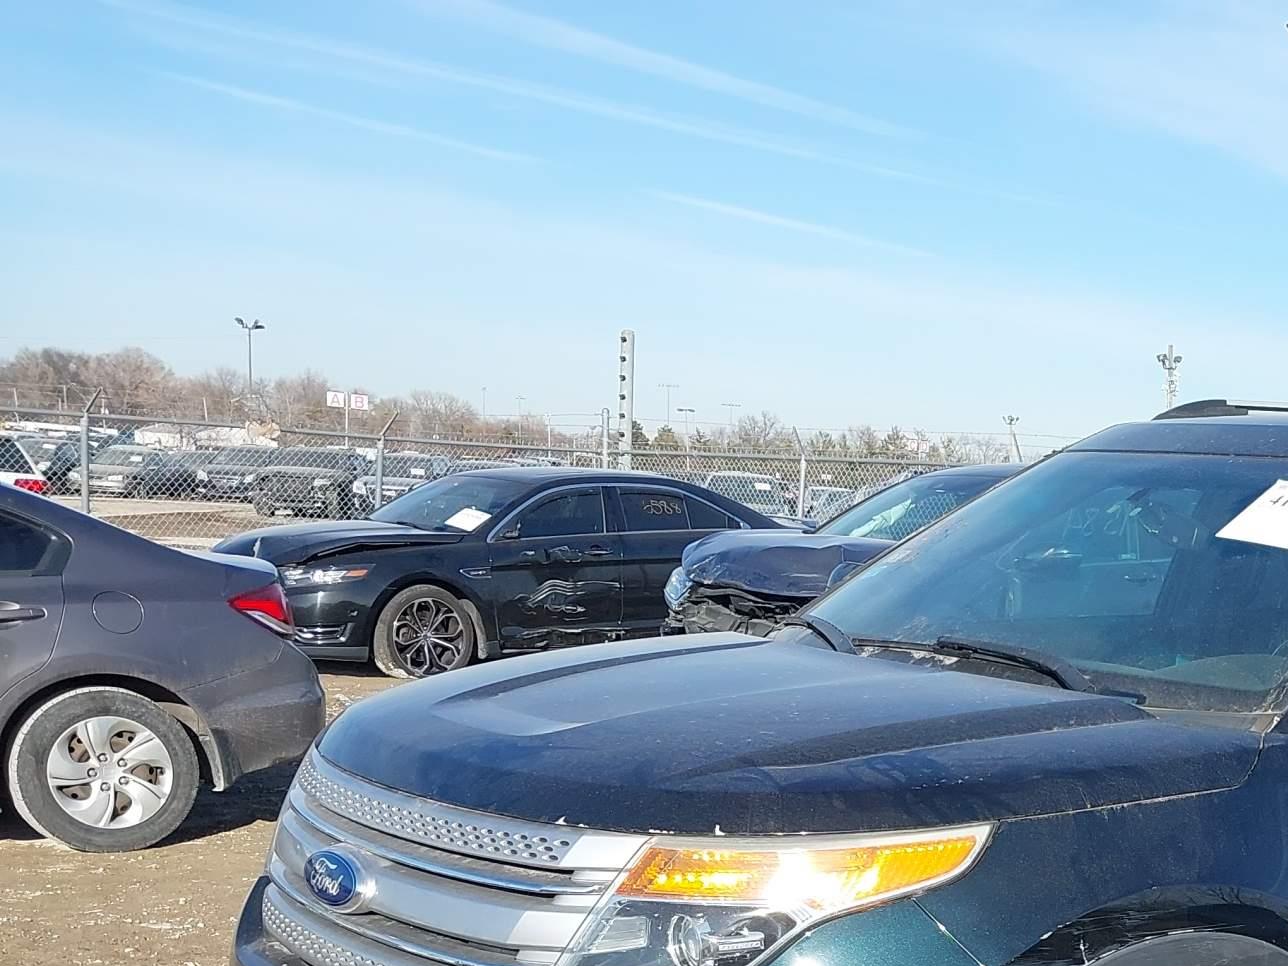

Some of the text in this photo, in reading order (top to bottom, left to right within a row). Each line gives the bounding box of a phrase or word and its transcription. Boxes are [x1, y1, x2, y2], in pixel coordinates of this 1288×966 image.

[330, 393, 341, 406] A
[354, 396, 364, 408] B
[311, 857, 344, 896] Ford
